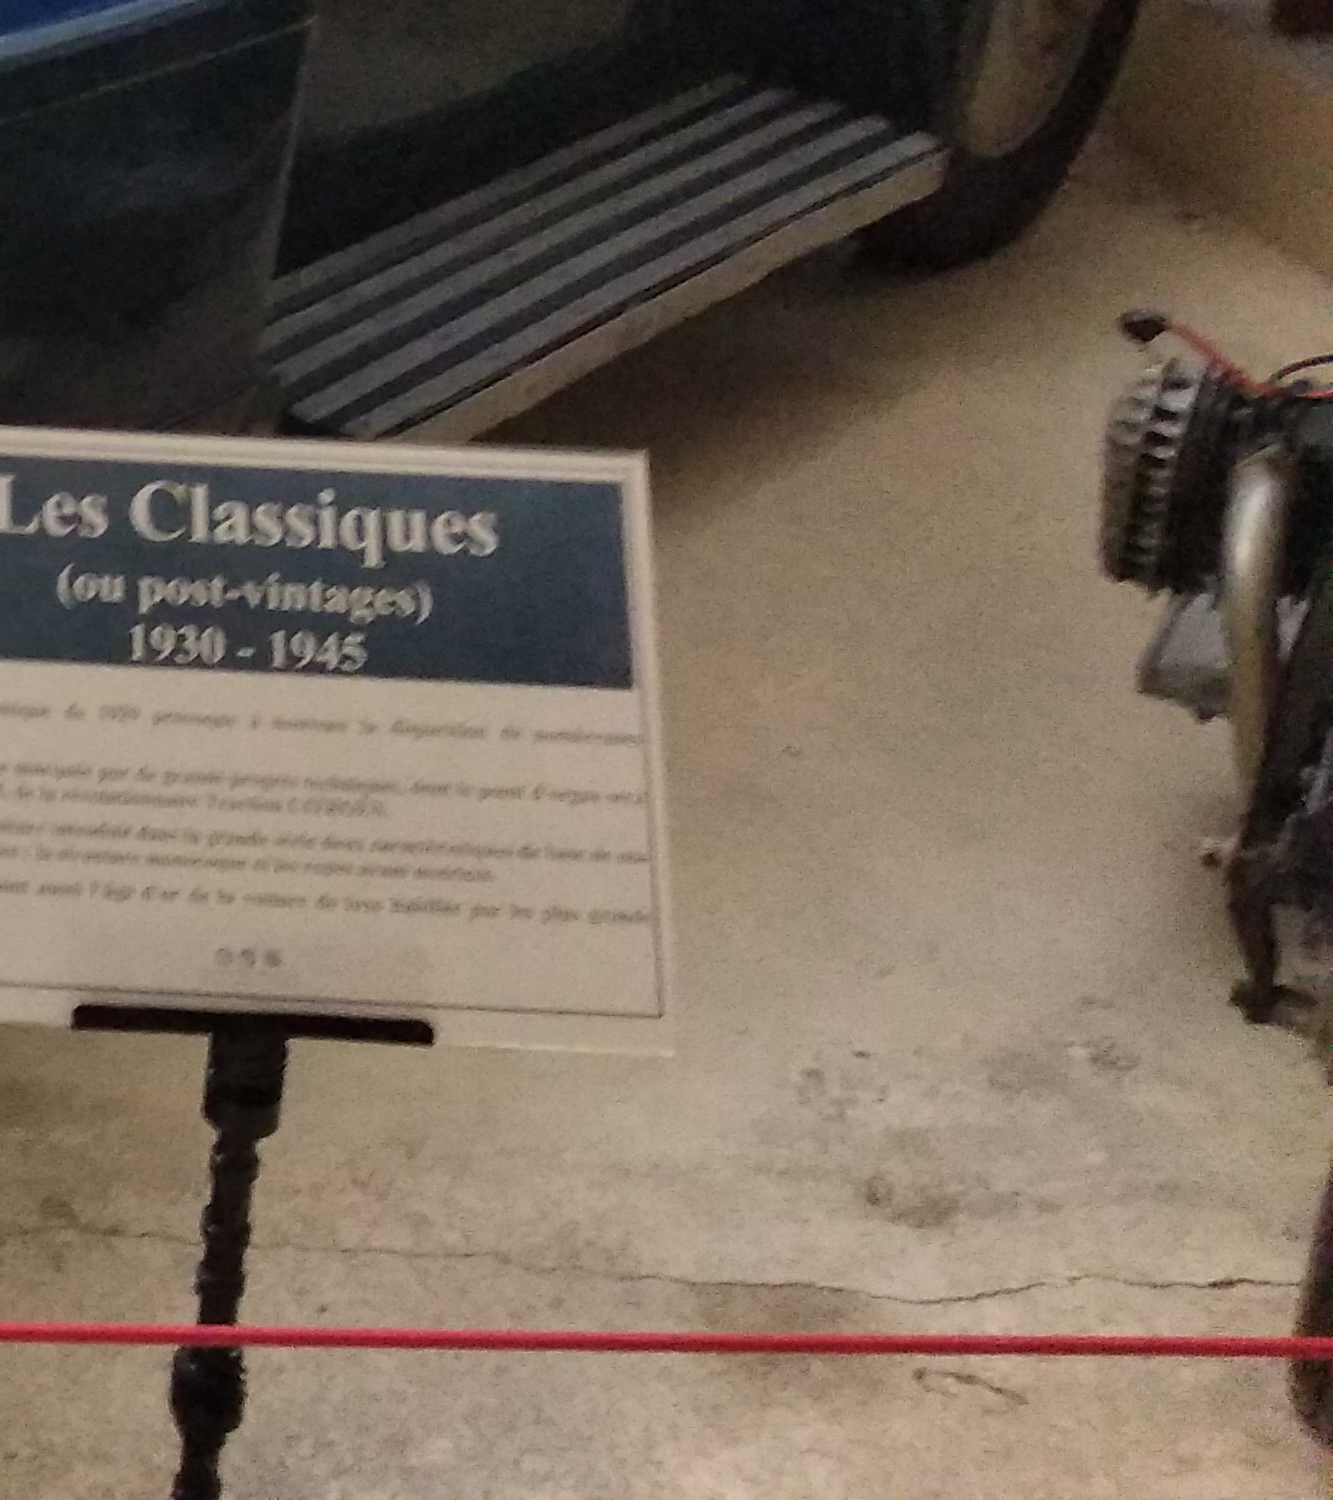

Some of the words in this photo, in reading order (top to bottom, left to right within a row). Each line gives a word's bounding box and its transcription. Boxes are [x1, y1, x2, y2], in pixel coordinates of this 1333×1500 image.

[129, 479, 501, 569] Classiques
[56, 563, 126, 609] (ou
[137, 572, 435, 626] post-vintages)
[131, 622, 226, 665] 1930
[269, 628, 368, 672] 1945
